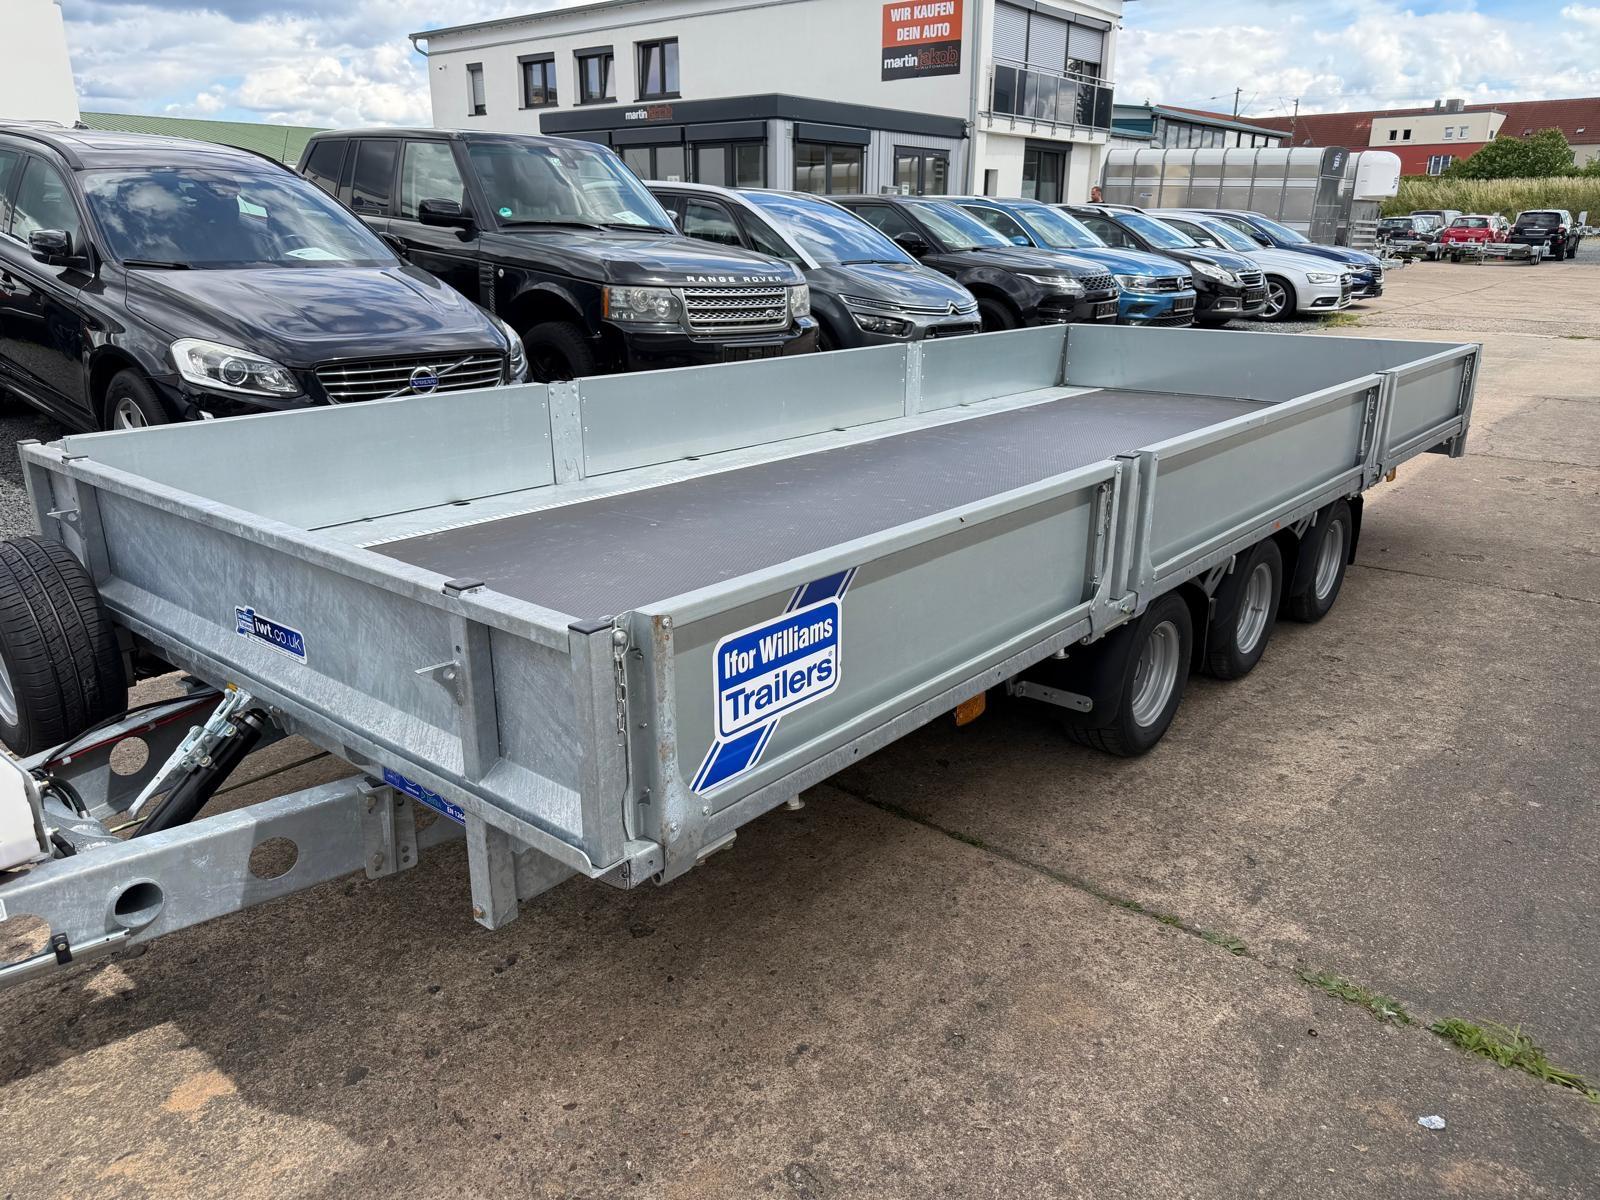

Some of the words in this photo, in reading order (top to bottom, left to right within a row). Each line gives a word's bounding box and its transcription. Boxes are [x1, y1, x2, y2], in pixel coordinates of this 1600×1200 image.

[890, 7, 911, 22] WIR
[913, 1, 955, 19] KAUFEN
[896, 26, 920, 41] DEIN
[923, 22, 950, 39] AUTO
[686, 275, 736, 283] RANGE
[743, 275, 782, 283] ROVER
[254, 617, 302, 652] iwt.co.uk
[724, 648, 757, 680] Ifor
[758, 617, 833, 664] Williams
[725, 657, 833, 722] Trailers
